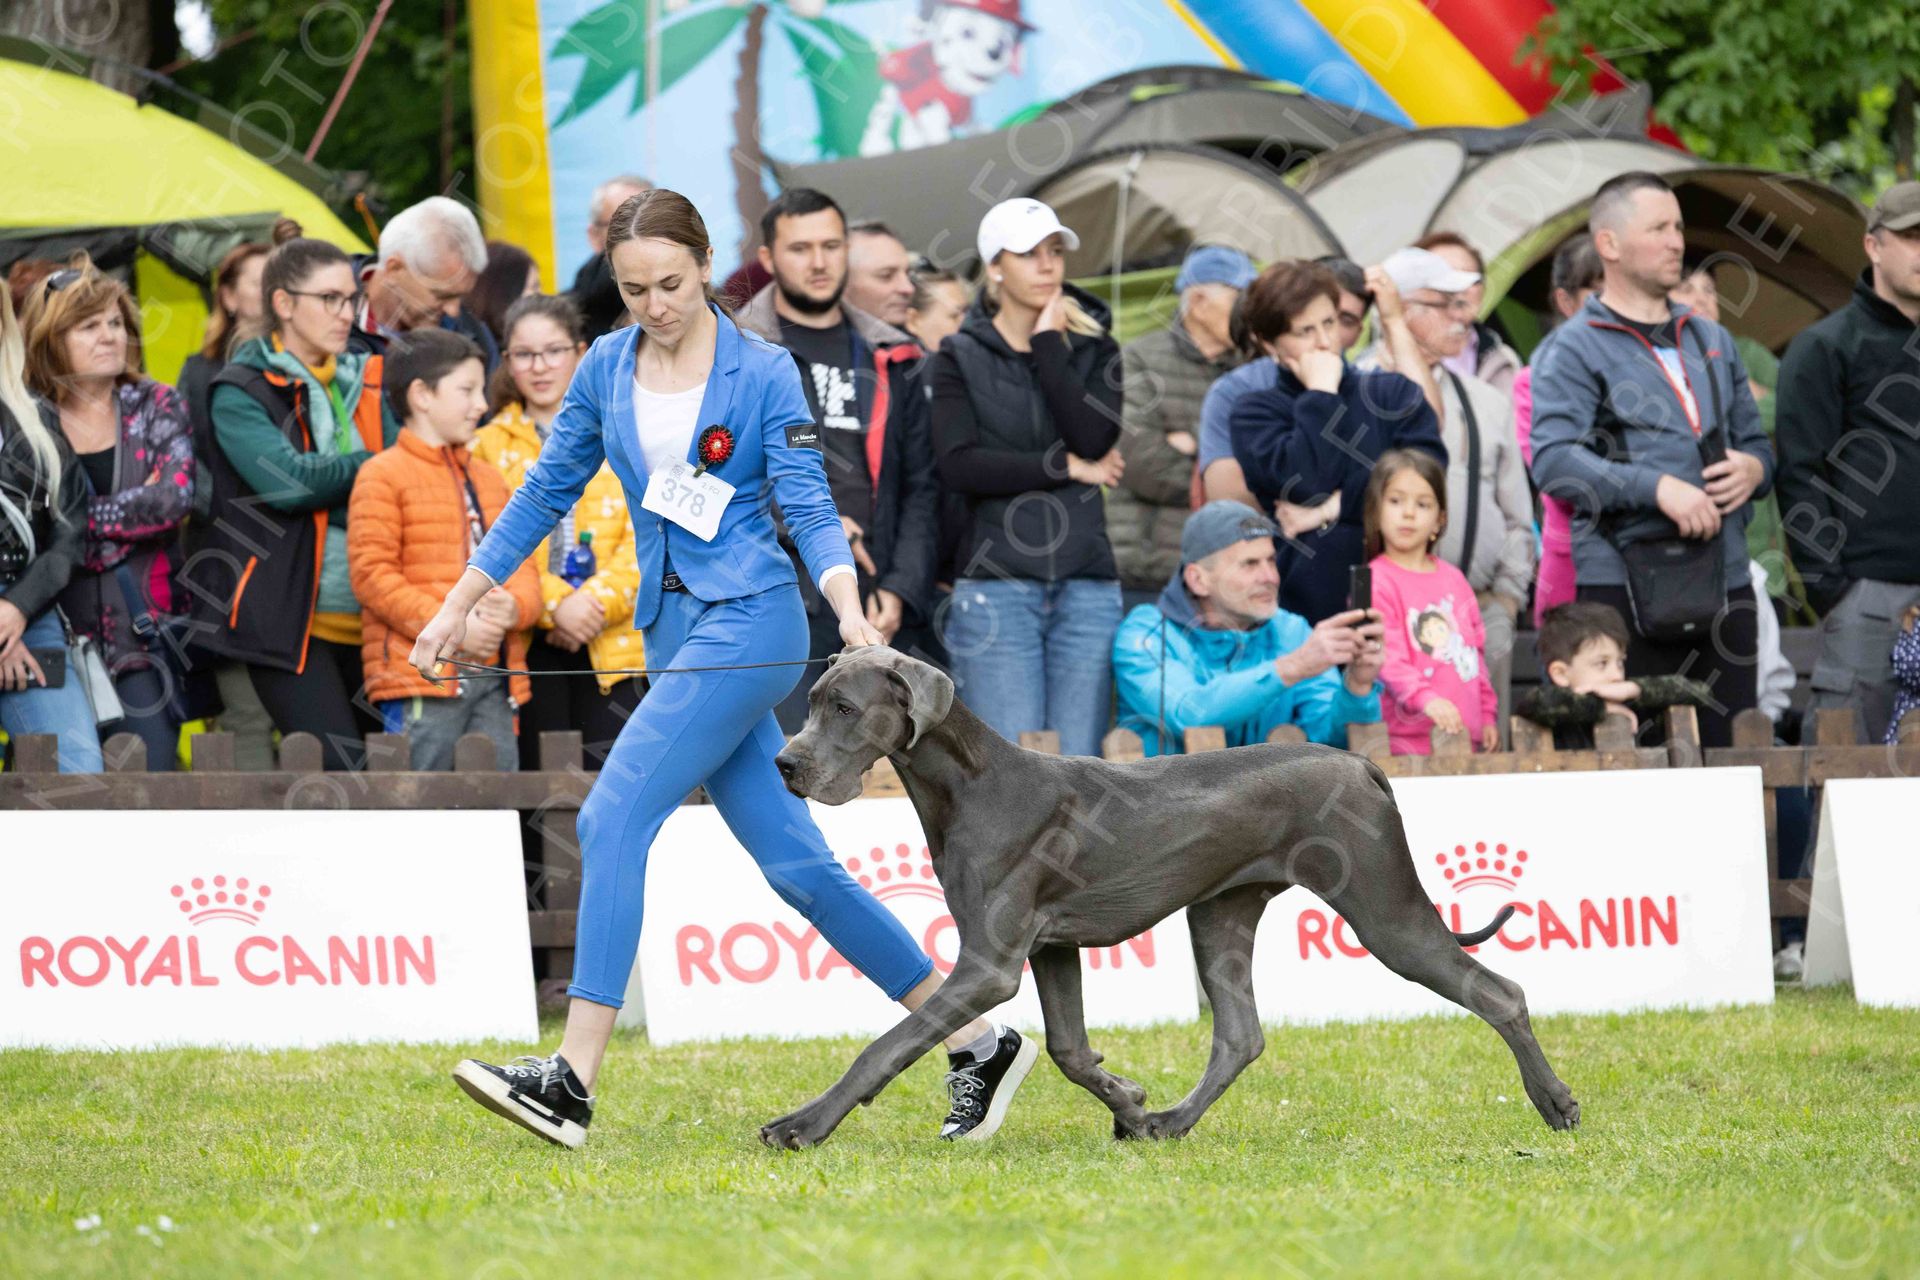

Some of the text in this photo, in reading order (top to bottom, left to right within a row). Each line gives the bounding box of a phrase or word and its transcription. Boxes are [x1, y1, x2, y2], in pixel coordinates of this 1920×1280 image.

[661, 478, 706, 518] 378
[1496, 896, 1679, 953] CANIN
[20, 935, 436, 988] ROYAL CANIN
